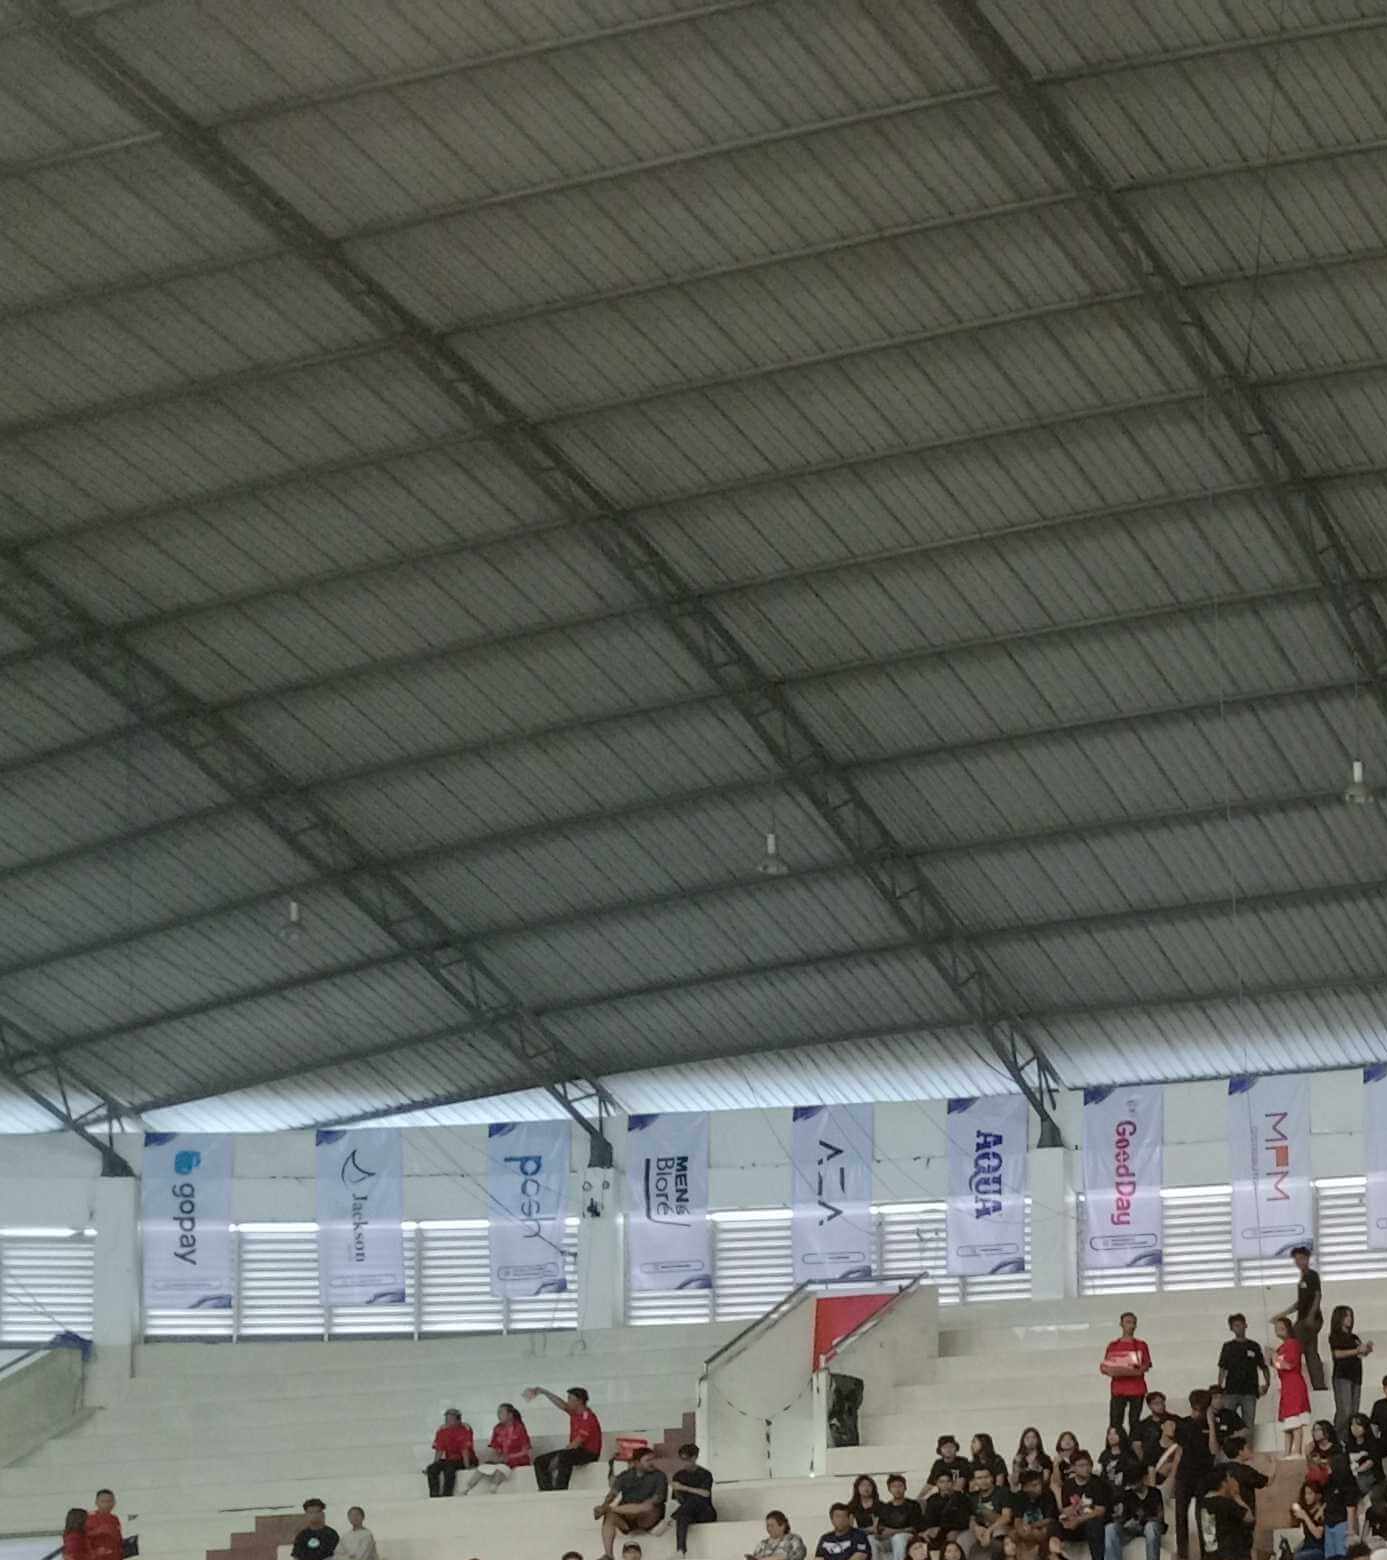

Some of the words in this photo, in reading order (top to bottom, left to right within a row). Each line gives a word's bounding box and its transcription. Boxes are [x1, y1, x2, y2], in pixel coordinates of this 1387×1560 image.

[969, 1130, 1003, 1220] AQUA
[172, 1183, 199, 1265] gopay
[350, 1193, 369, 1262] Jackson
